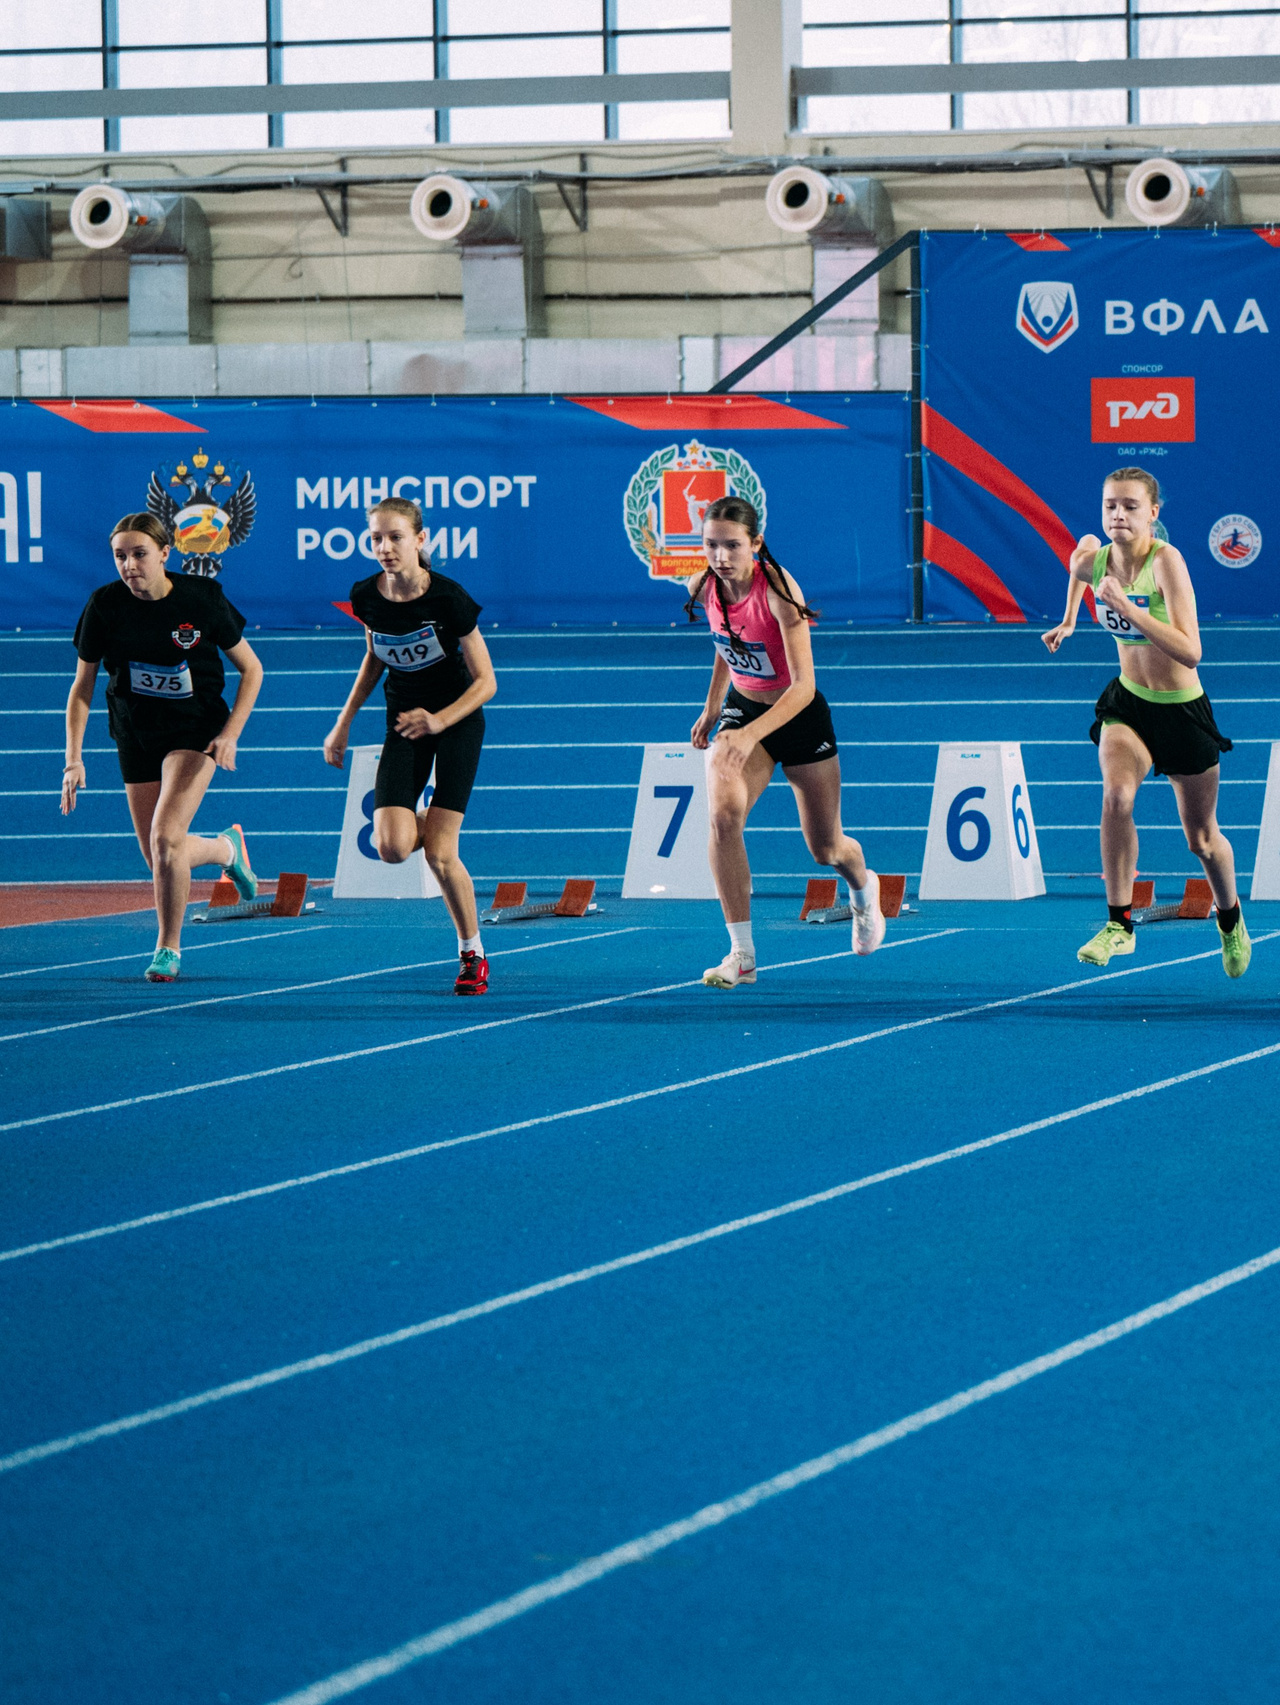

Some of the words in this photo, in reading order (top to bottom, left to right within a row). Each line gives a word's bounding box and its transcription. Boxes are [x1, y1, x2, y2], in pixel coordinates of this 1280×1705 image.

[1105, 298, 1269, 336] ВФЛА
[1121, 364, 1164, 374] СПОНСОР
[1117, 447, 1136, 456] ОАО
[296, 475, 537, 510] МИНСПОРТ
[297, 526, 478, 560] РОСИИ
[387, 643, 429, 664] 119
[724, 647, 763, 671] 330
[140, 672, 183, 692] 375
[653, 785, 694, 858] 7
[946, 786, 992, 863] 6
[1011, 783, 1030, 859] 6
